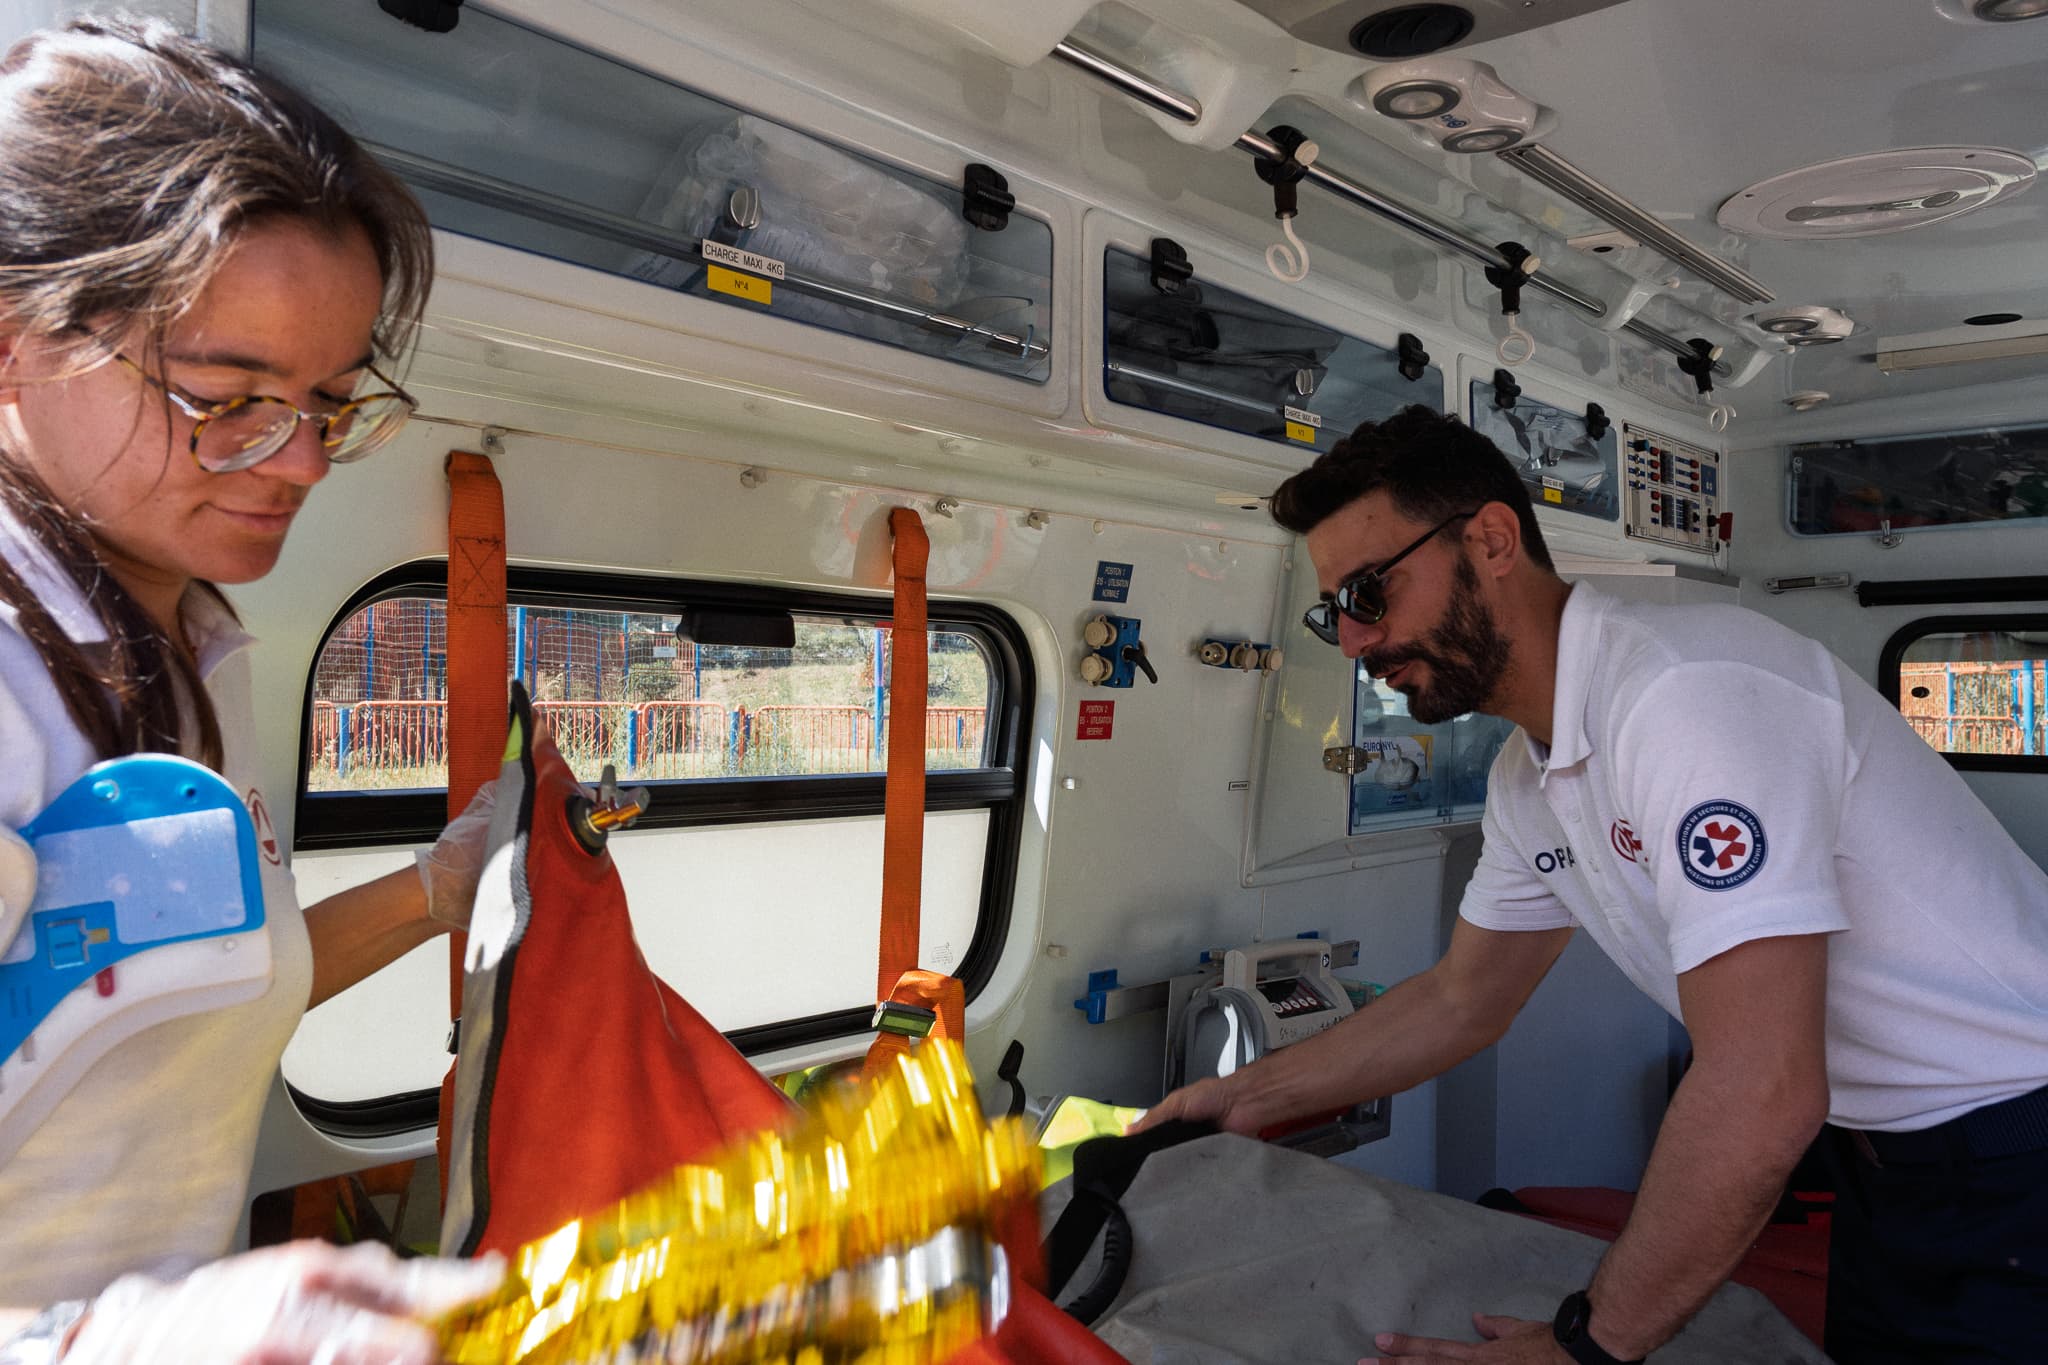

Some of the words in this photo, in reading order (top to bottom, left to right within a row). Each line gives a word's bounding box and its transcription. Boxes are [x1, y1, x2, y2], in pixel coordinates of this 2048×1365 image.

[704, 244, 739, 263] CHARGE
[744, 255, 762, 270] MAXI
[766, 262, 783, 276] 4KG
[1686, 866, 1714, 886] MISSIONS
[1715, 878, 1725, 886] DE
[1753, 843, 1762, 864] CIVILE
